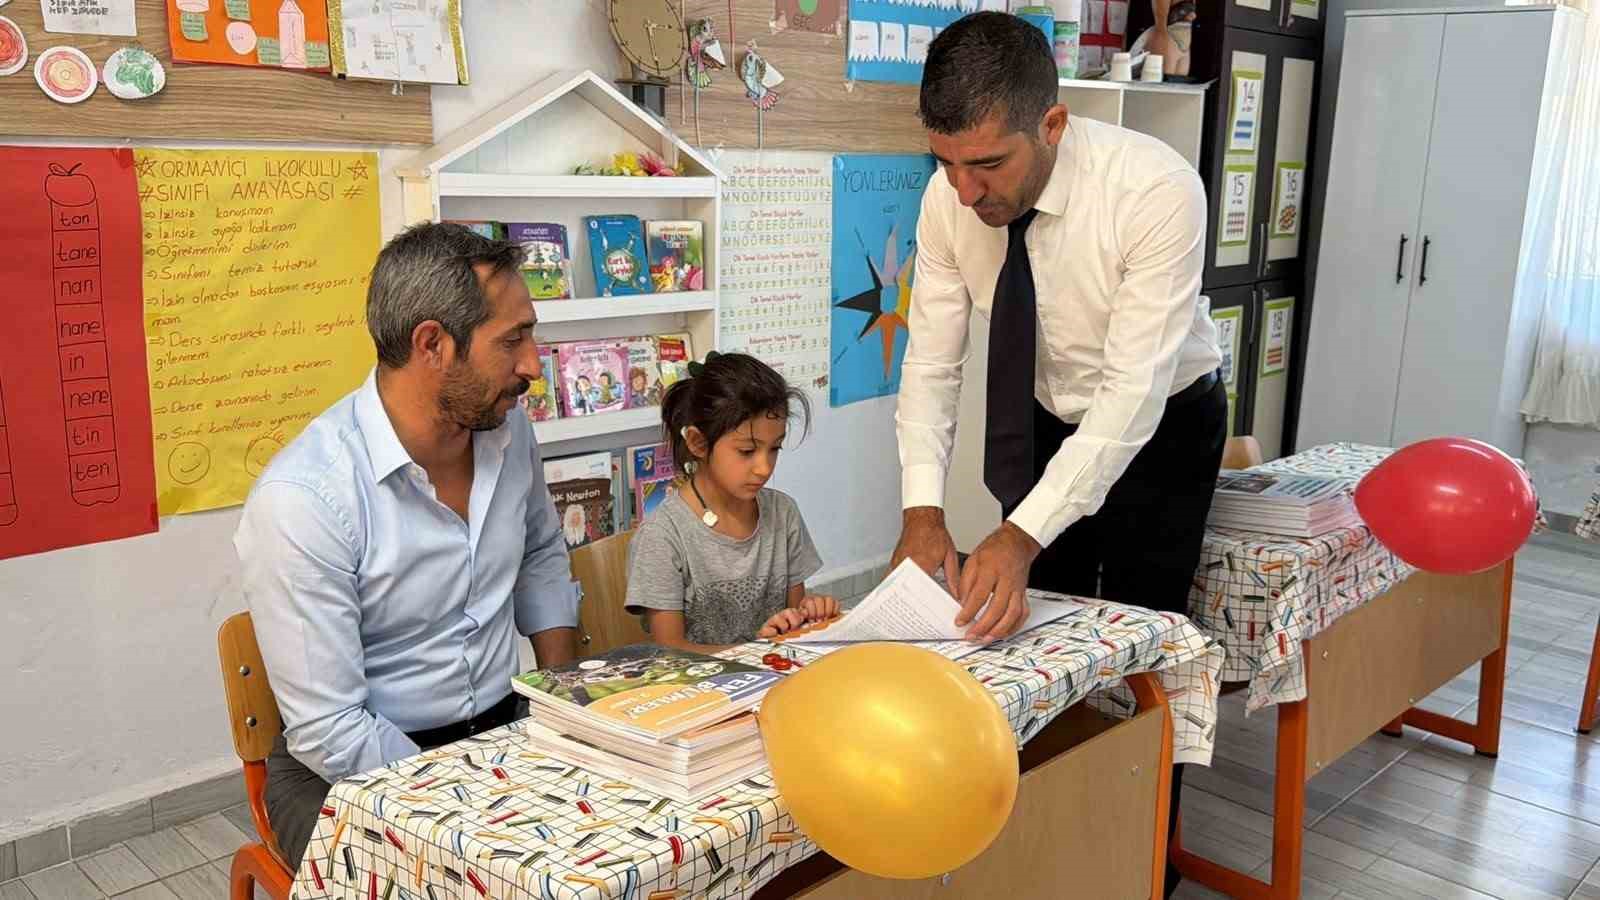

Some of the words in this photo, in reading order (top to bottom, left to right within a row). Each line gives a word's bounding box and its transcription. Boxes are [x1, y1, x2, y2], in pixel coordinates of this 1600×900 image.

[1233, 174, 1246, 197] 15
[60, 211, 90, 227] tan
[56, 241, 97, 262] tane
[60, 278, 94, 297] nan
[60, 319, 101, 337] nane
[68, 352, 85, 373] in
[71, 427, 101, 446] tin
[74, 461, 111, 481] ten
[565, 487, 601, 503] Newton
[714, 673, 763, 693] FEN
